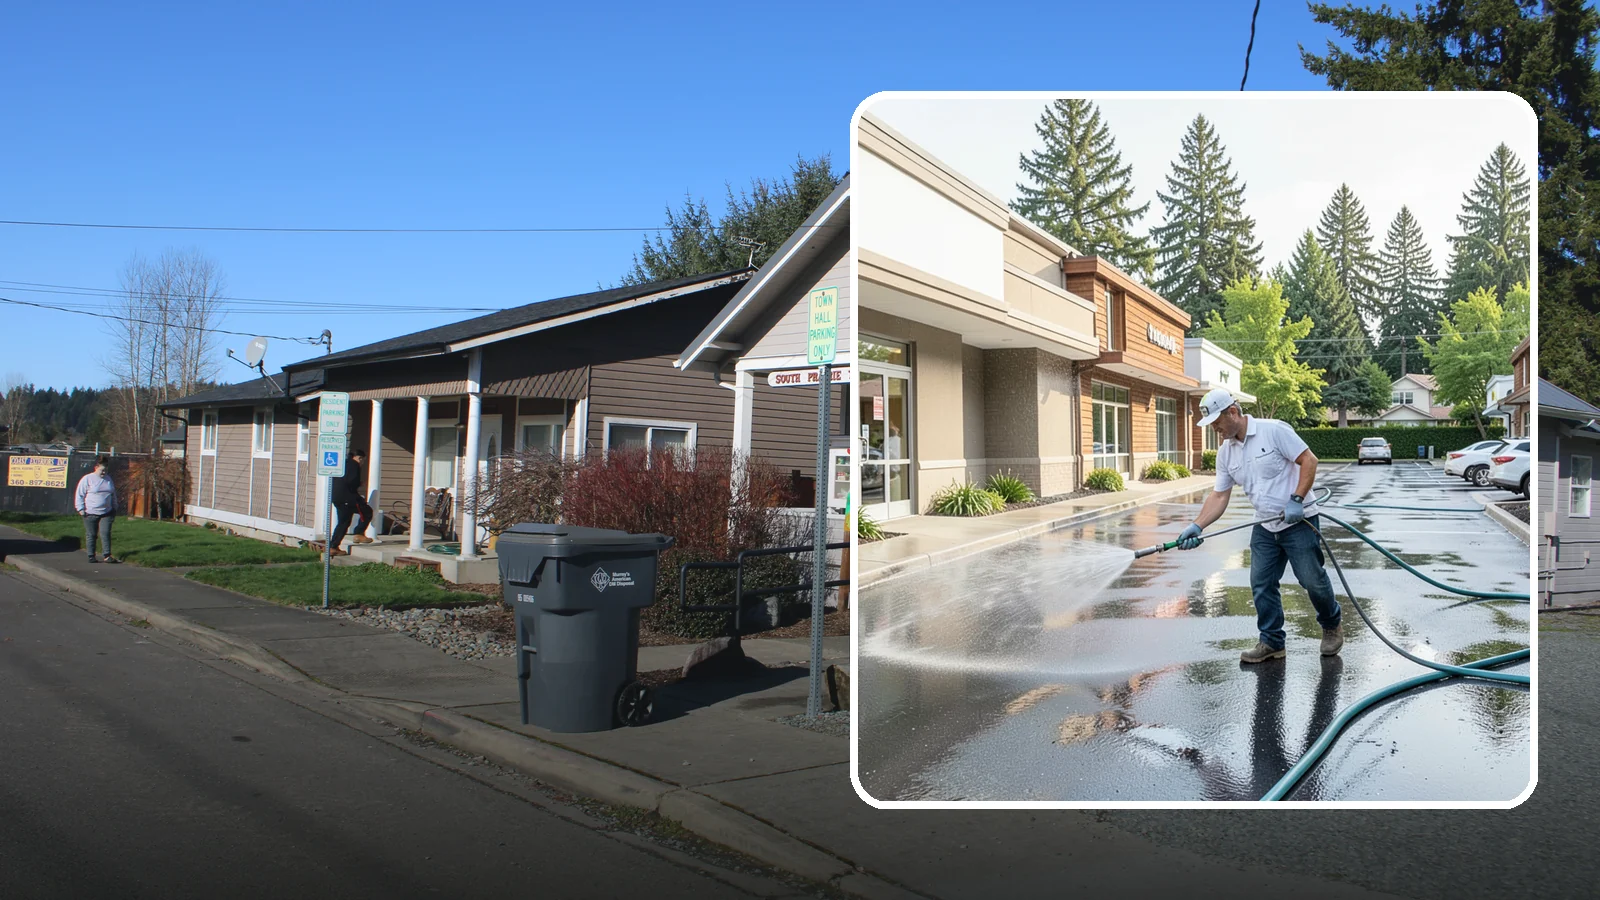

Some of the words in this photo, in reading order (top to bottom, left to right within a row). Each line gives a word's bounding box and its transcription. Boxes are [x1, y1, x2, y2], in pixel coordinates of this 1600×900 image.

[815, 295, 833, 308] TOWN
[814, 311, 831, 324] HALL
[809, 326, 836, 340] PARKING
[813, 344, 831, 357] ONLY
[775, 373, 801, 384] SOUTH
[807, 370, 842, 382] PRIE
